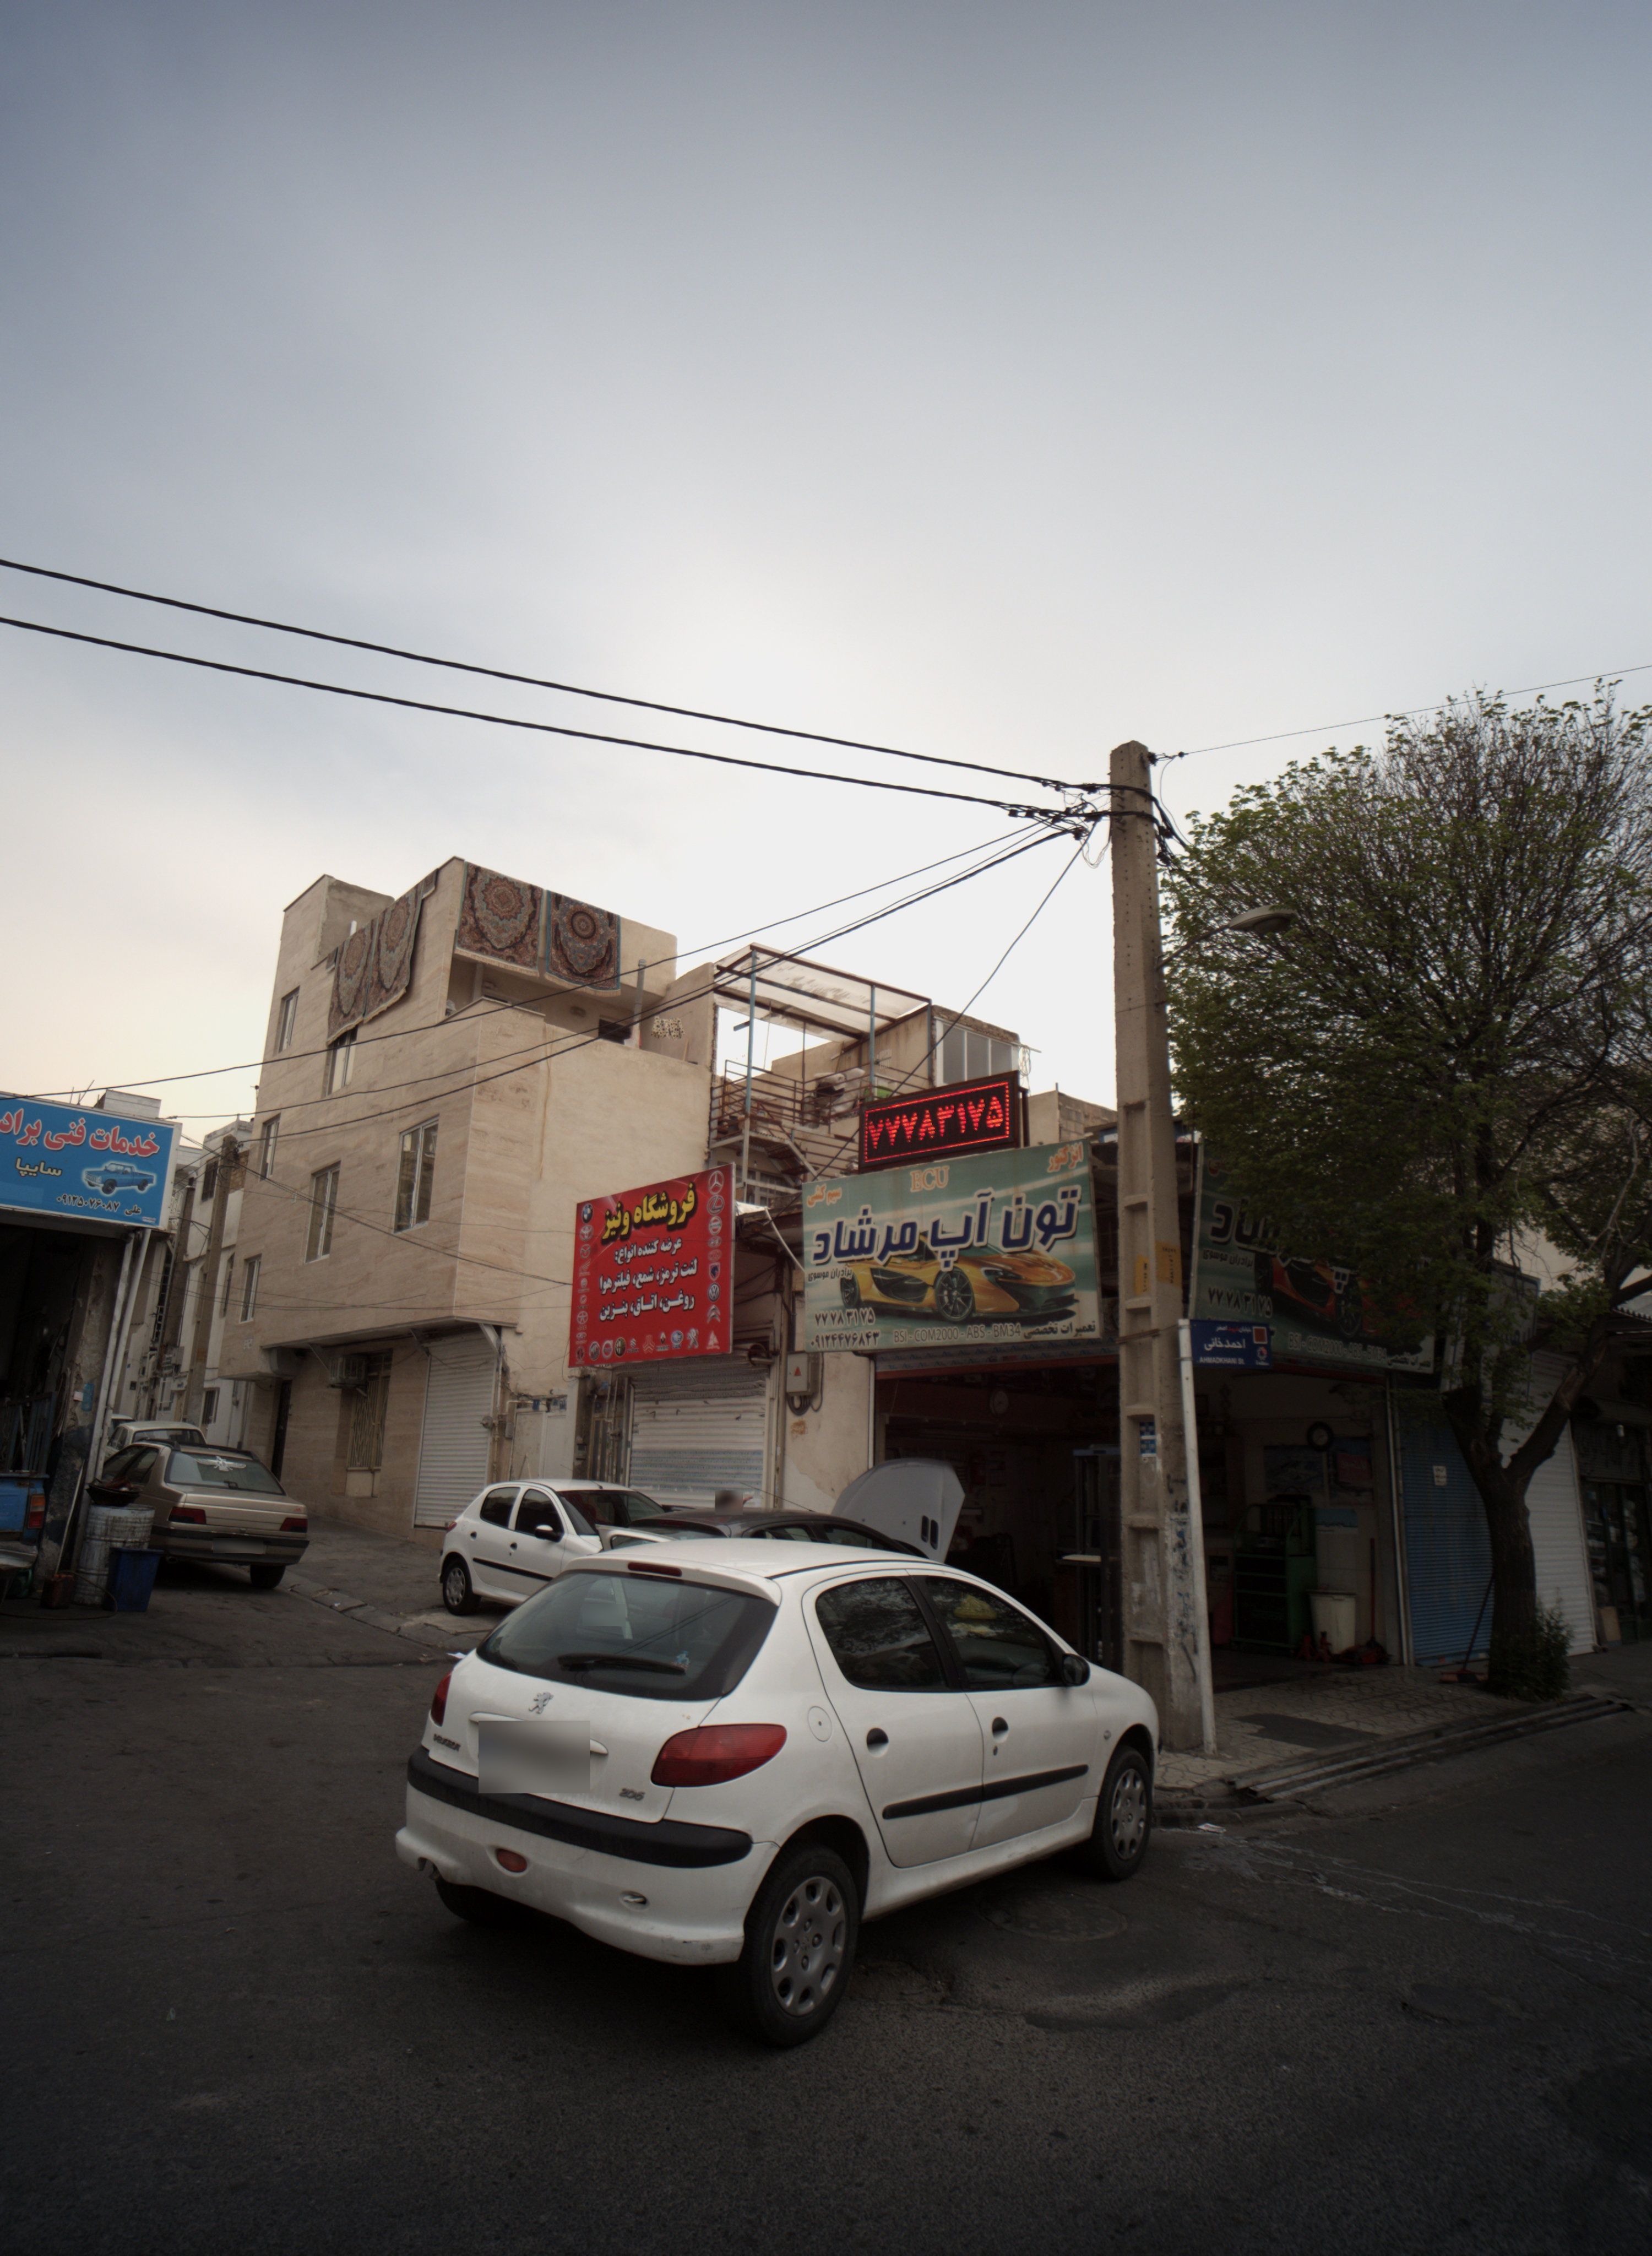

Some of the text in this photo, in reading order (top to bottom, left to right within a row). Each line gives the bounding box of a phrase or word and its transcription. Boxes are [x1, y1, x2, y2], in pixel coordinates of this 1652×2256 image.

[868, 1096, 1003, 1149] ۷۷۷۸۳۱۷۵
[44, 1118, 86, 1150] فنی
[90, 1126, 160, 1157] خدمات
[15, 1157, 63, 1177] سایپا
[910, 1166, 949, 1192] ECU
[124, 1205, 141, 1216] علی
[601, 1182, 696, 1240] فروشگاه ونیز
[811, 1185, 1080, 1271] تون آپ مرشاد
[637, 1239, 660, 1256] کننده
[660, 1238, 683, 1256] عرضه
[680, 1257, 698, 1278] لنت
[830, 1267, 852, 1279] برادران
[599, 1300, 629, 1322] بنزین
[894, 1323, 1021, 1343] BSI COM2000 ABS BM34
